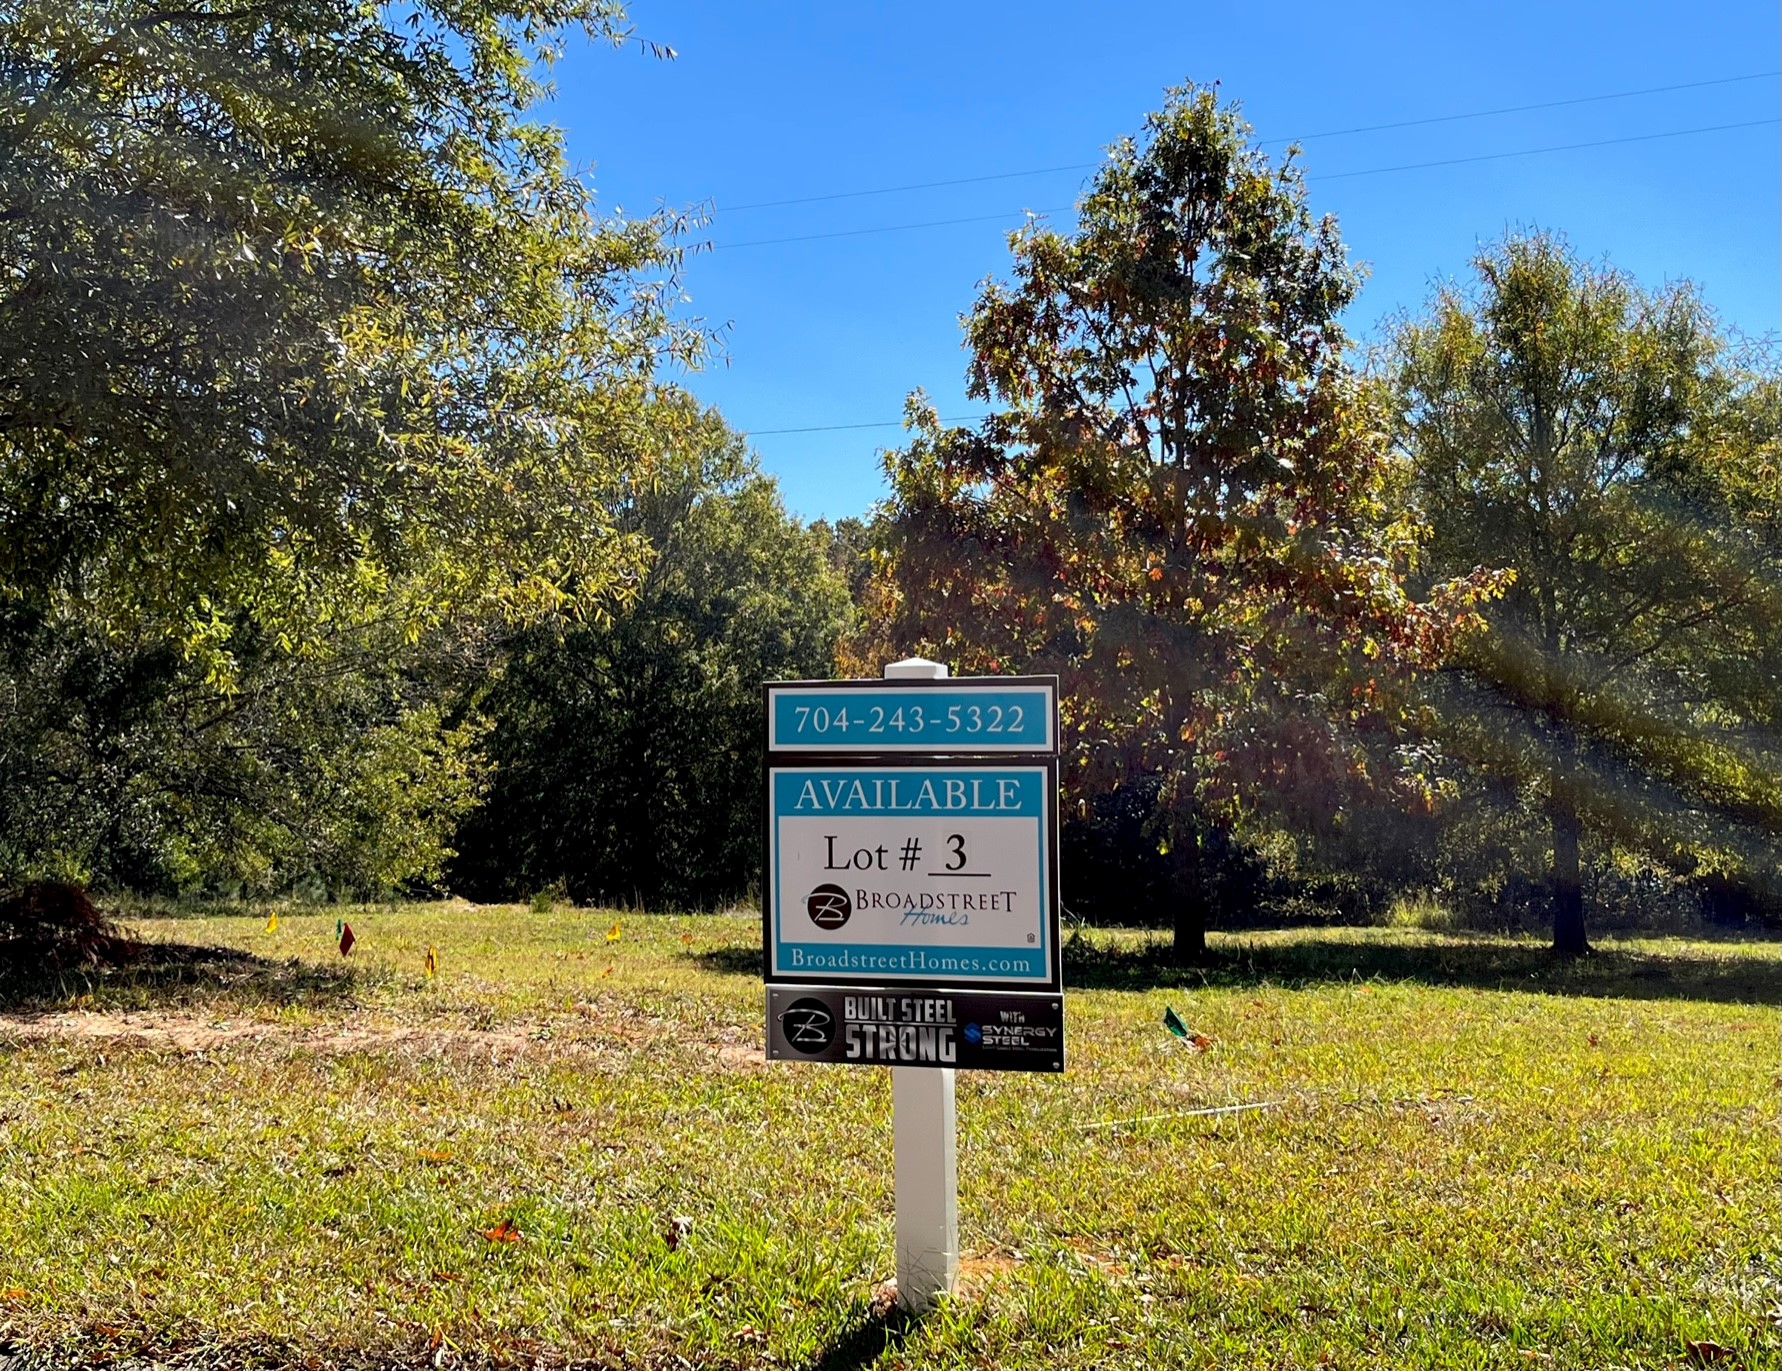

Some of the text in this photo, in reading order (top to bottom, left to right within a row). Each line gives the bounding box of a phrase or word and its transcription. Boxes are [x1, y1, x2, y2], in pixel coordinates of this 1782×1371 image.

[795, 704, 1025, 733] 704-243-5322
[794, 778, 1022, 810] AVAILABLE
[824, 834, 967, 871] Lot # 3
[856, 889, 1016, 912] BROADSTREET
[900, 904, 969, 927] Homes
[791, 949, 1030, 972] BroadstreetHomes.com
[844, 996, 957, 1023] BUILT STEEL
[999, 1010, 1025, 1024] WITH
[982, 1025, 1057, 1037] SYNERGY
[982, 1035, 1030, 1046] STEEL
[845, 1025, 957, 1063] STRONG
